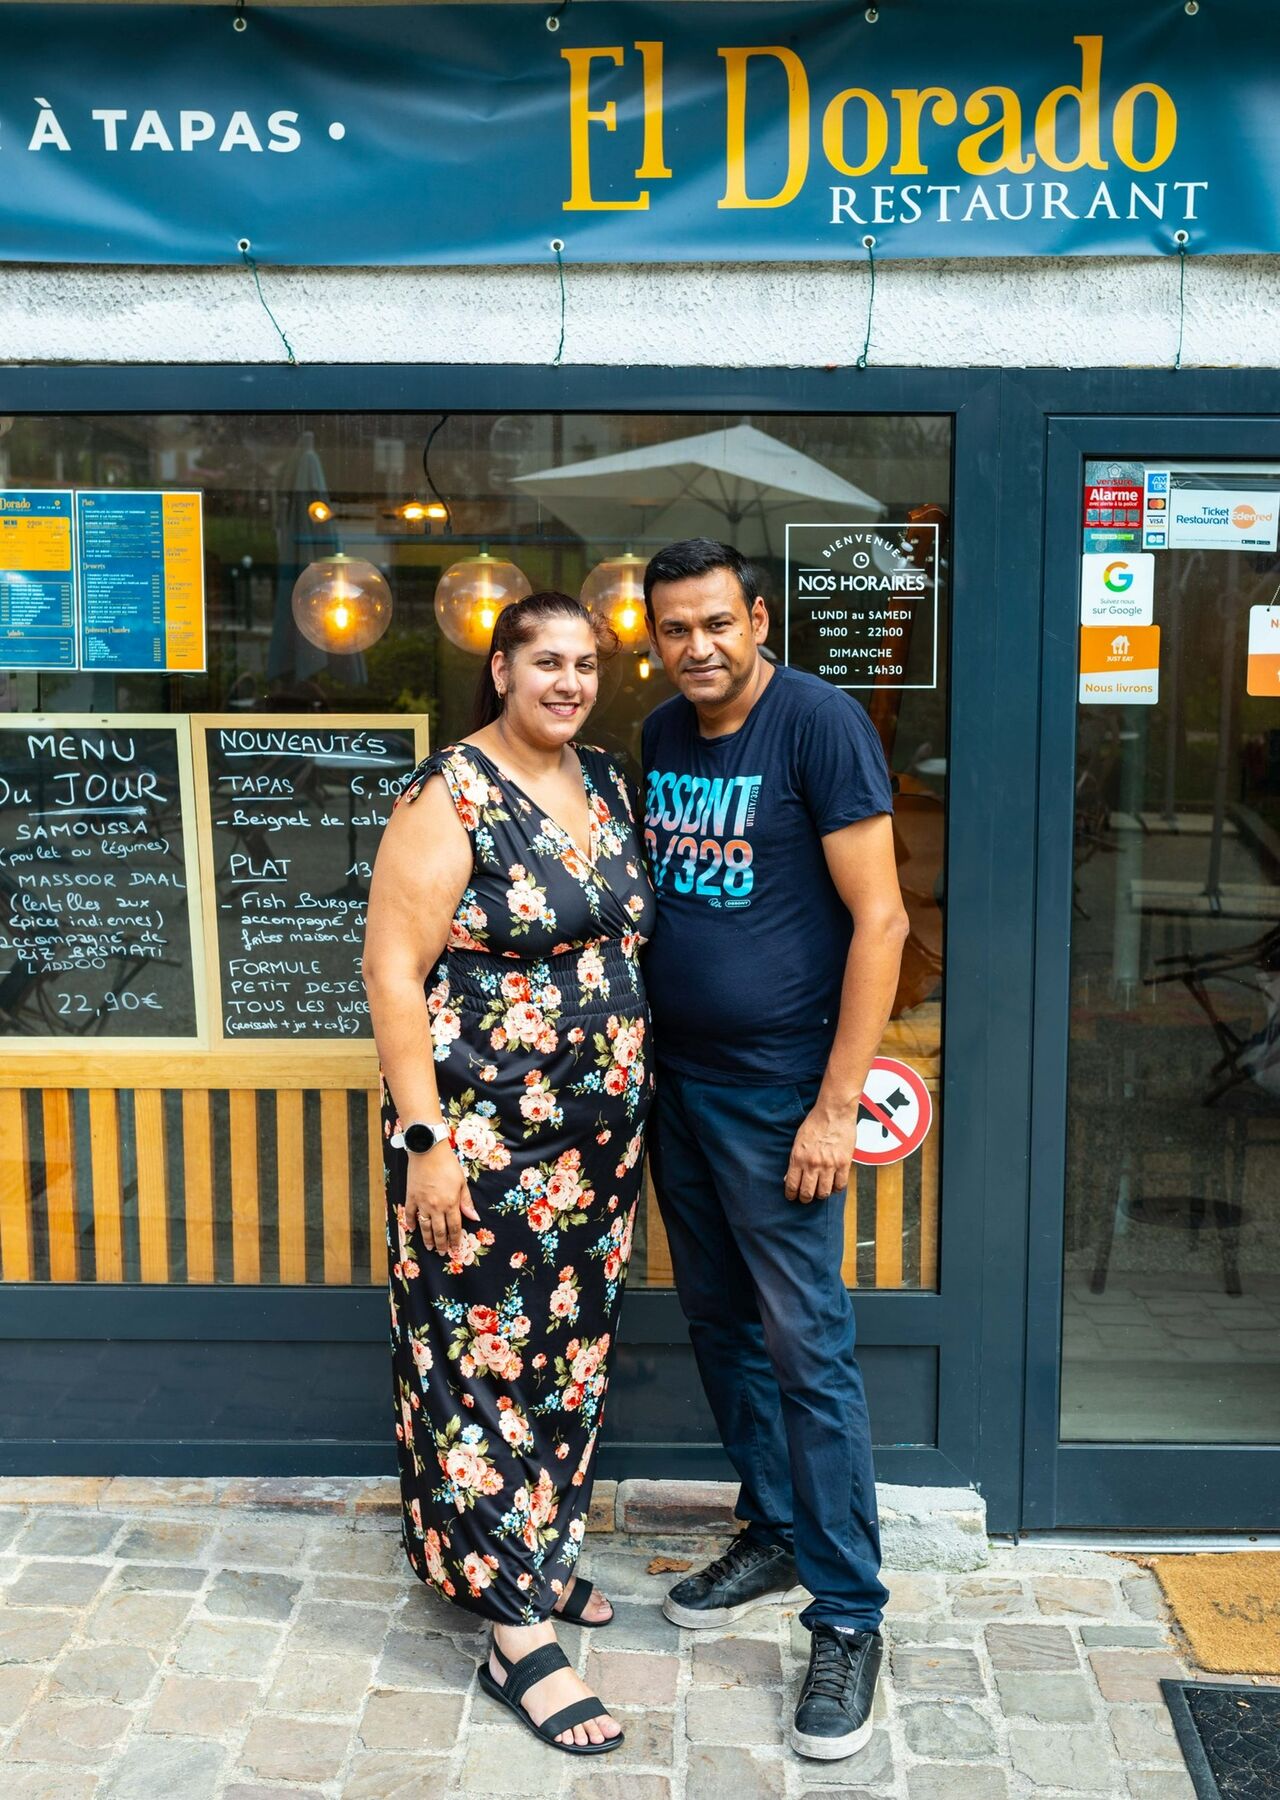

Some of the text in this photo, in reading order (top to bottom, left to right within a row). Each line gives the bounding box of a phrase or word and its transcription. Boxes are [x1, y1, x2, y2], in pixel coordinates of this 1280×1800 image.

[28, 97, 301, 152] À TAPAS
[560, 35, 1177, 212] El Dorado
[829, 181, 1208, 225] RESTAURANT
[1090, 488, 1138, 501] Alarme
[1202, 507, 1229, 516] Ticket
[1232, 512, 1272, 522] Edenred
[1176, 515, 1229, 525] Restaurant
[822, 534, 901, 559] BIENVENUE
[798, 575, 925, 591] NOS HORAIRES
[811, 610, 912, 620] LUNDI au SAMEDI
[1109, 606, 1142, 616] Google
[819, 627, 848, 637] 9h00
[867, 627, 903, 637] 22h00
[829, 648, 893, 658] DIMANCHE
[819, 665, 848, 675] 9h00
[867, 665, 903, 675] 14h30
[1085, 683, 1153, 693] Nous livrons
[28, 735, 135, 762] MENU
[220, 731, 387, 754] NOUVEAUTÉS
[53, 772, 167, 805] JOUR
[219, 776, 294, 793] TAPAS
[746, 786, 760, 827] UTILITY/328
[232, 810, 311, 831] Beignet
[320, 812, 344, 826] de
[351, 809, 390, 826] cala
[16, 819, 148, 841] SAMOUSSA
[72, 848, 91, 857] ou
[102, 838, 169, 859] légumes)
[230, 854, 291, 876] PLAT
[19, 872, 186, 888] MASSOOR DAAL
[116, 898, 150, 908] aux
[241, 892, 285, 909] Fish
[140, 934, 167, 944] de
[290, 931, 338, 942] maison
[343, 930, 362, 943] et
[28, 959, 106, 974] LADDOO
[229, 959, 322, 976] FORMULE
[58, 993, 162, 1016] 22,90€
[228, 1000, 285, 1013] TOUS
[297, 1000, 324, 1013] LES
